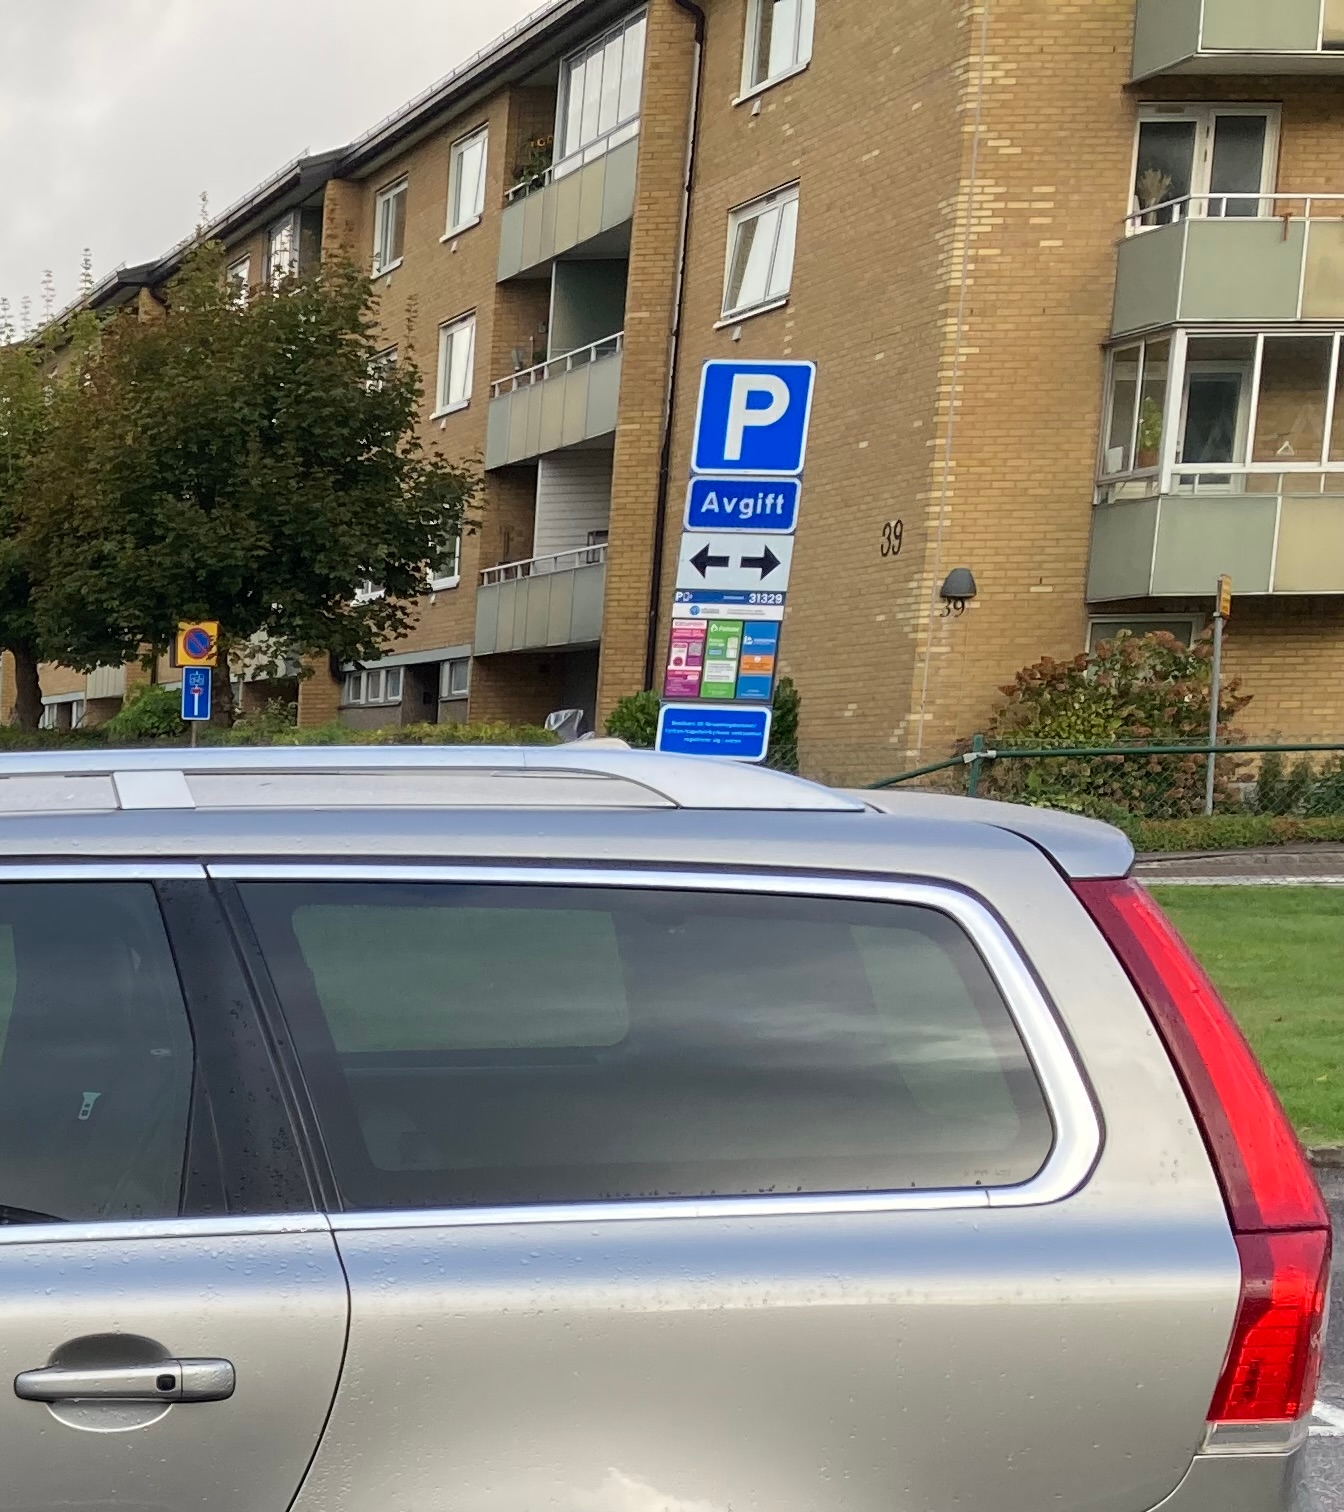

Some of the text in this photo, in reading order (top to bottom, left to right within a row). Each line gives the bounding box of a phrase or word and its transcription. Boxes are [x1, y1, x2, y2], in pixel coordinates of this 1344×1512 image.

[724, 373, 790, 460] P
[701, 491, 784, 519] Avgift
[881, 519, 903, 557] 39
[748, 593, 783, 604] 31329
[940, 598, 965, 618] 39
